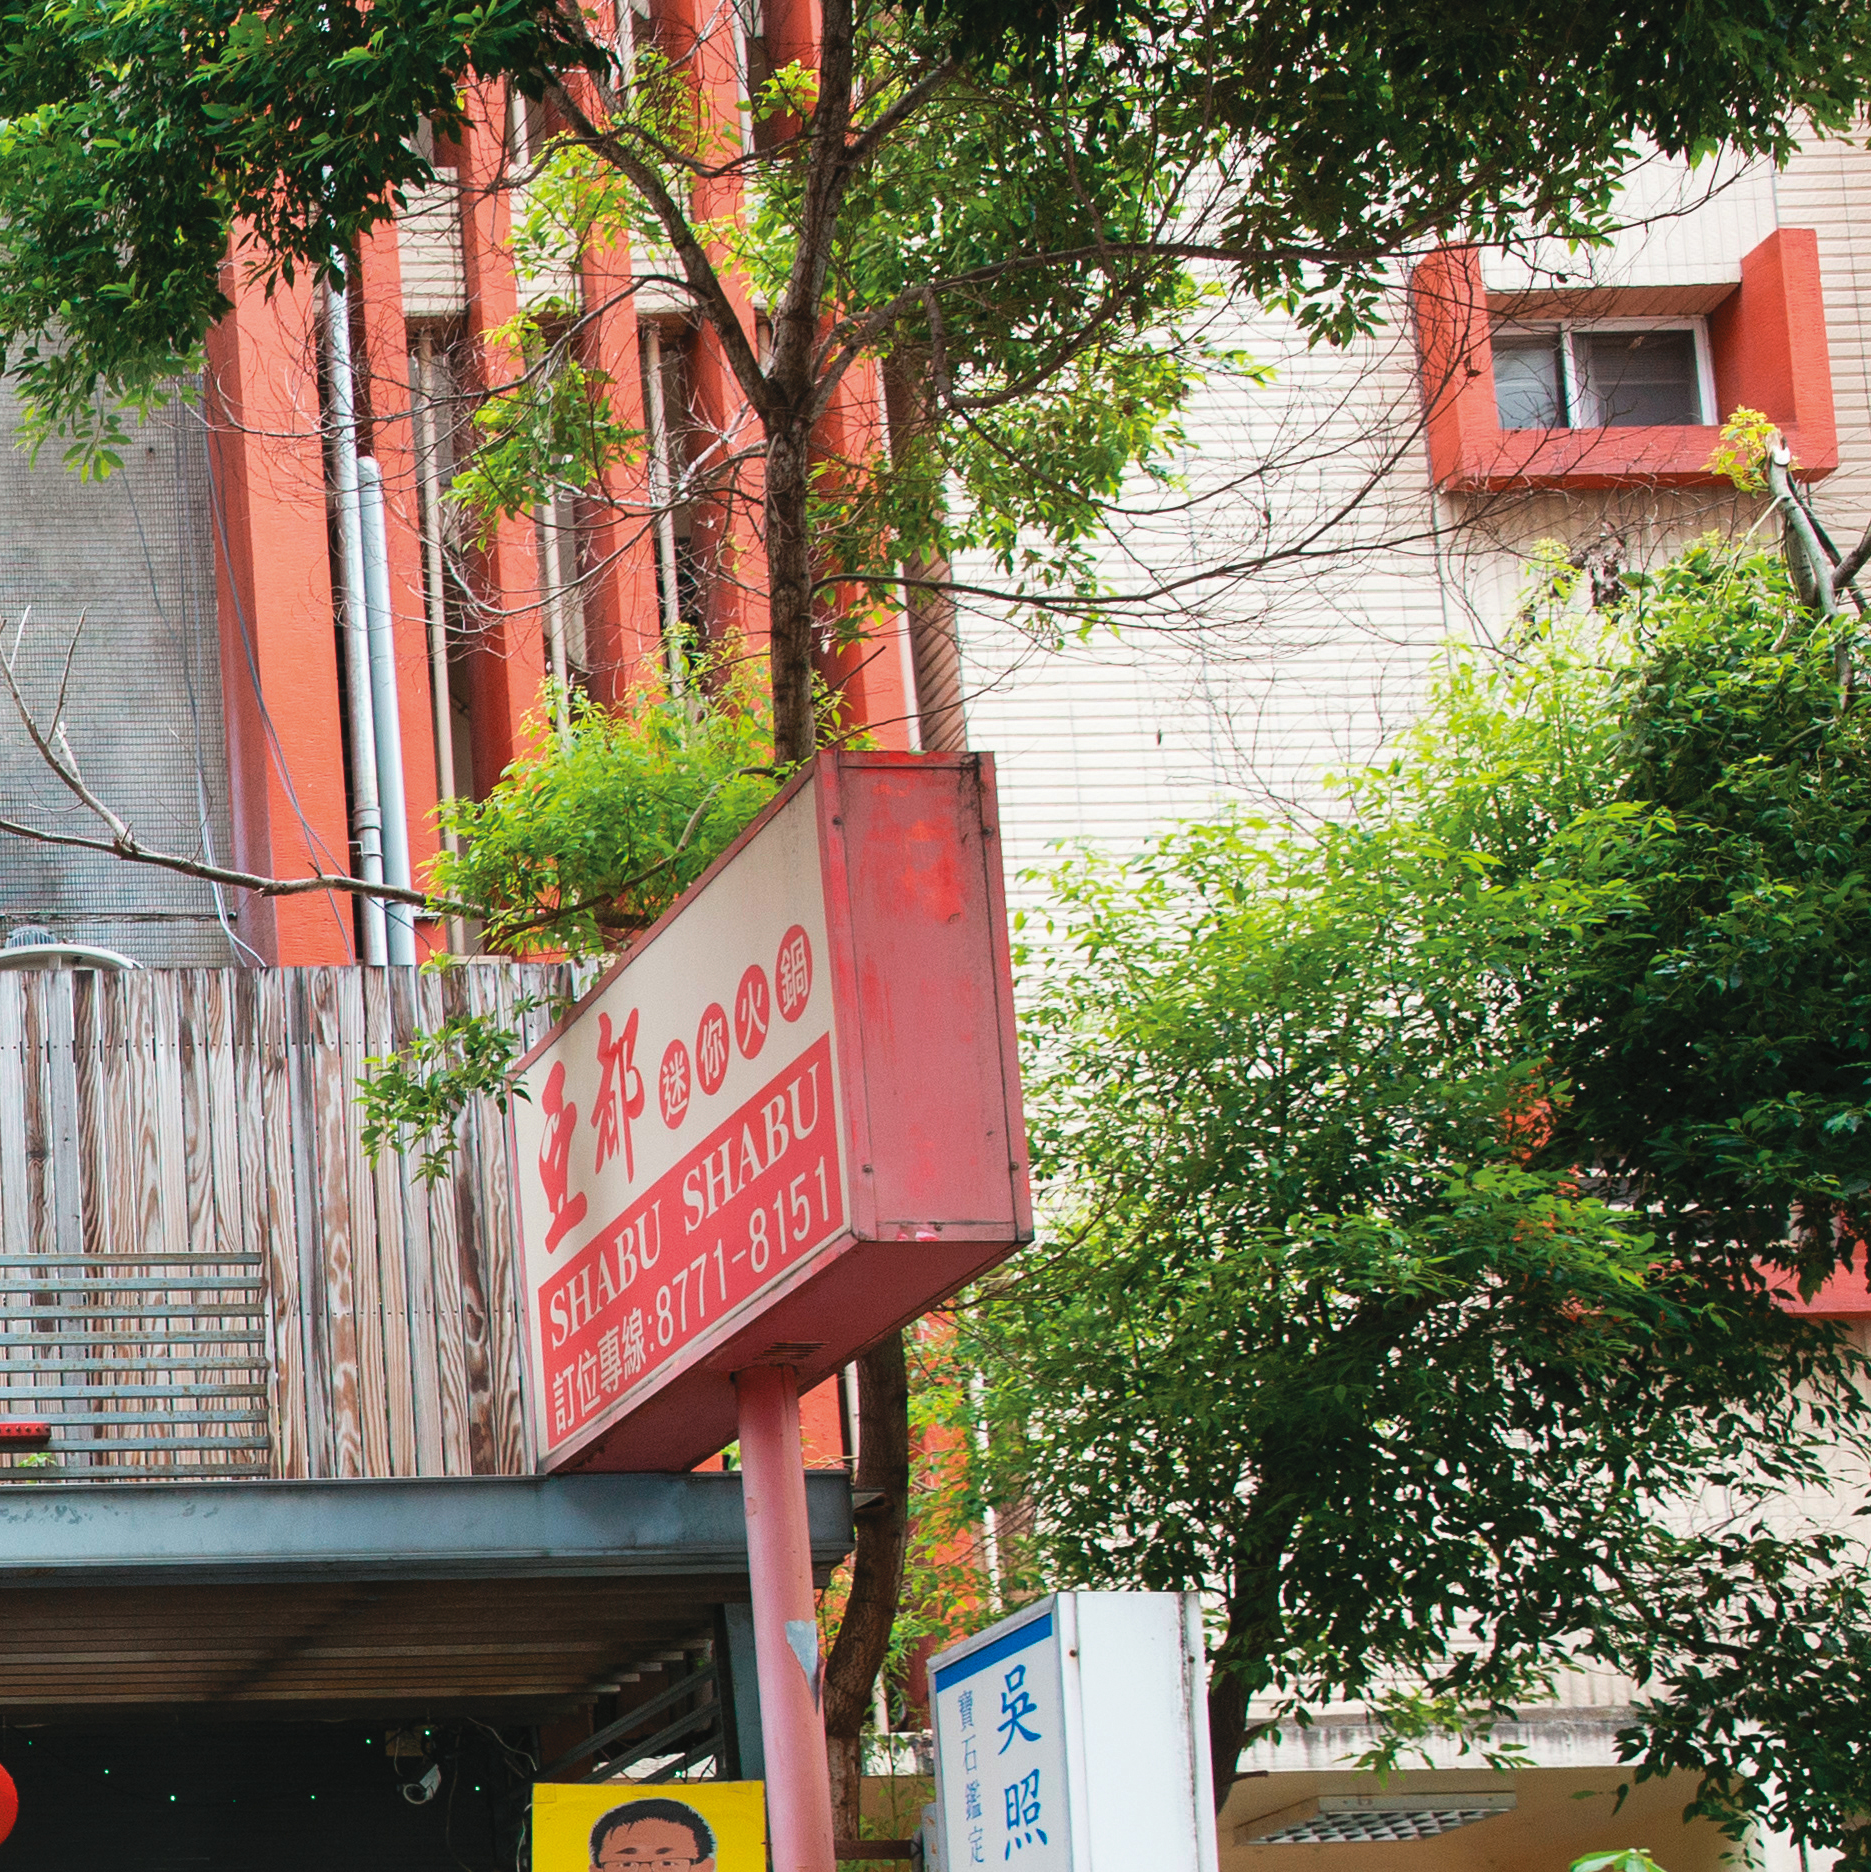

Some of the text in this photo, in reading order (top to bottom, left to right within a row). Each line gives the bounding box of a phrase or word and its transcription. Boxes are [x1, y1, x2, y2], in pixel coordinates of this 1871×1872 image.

[661, 936, 808, 1126] 迷你火鍋
[550, 1062, 819, 1349] SHABU SHABU
